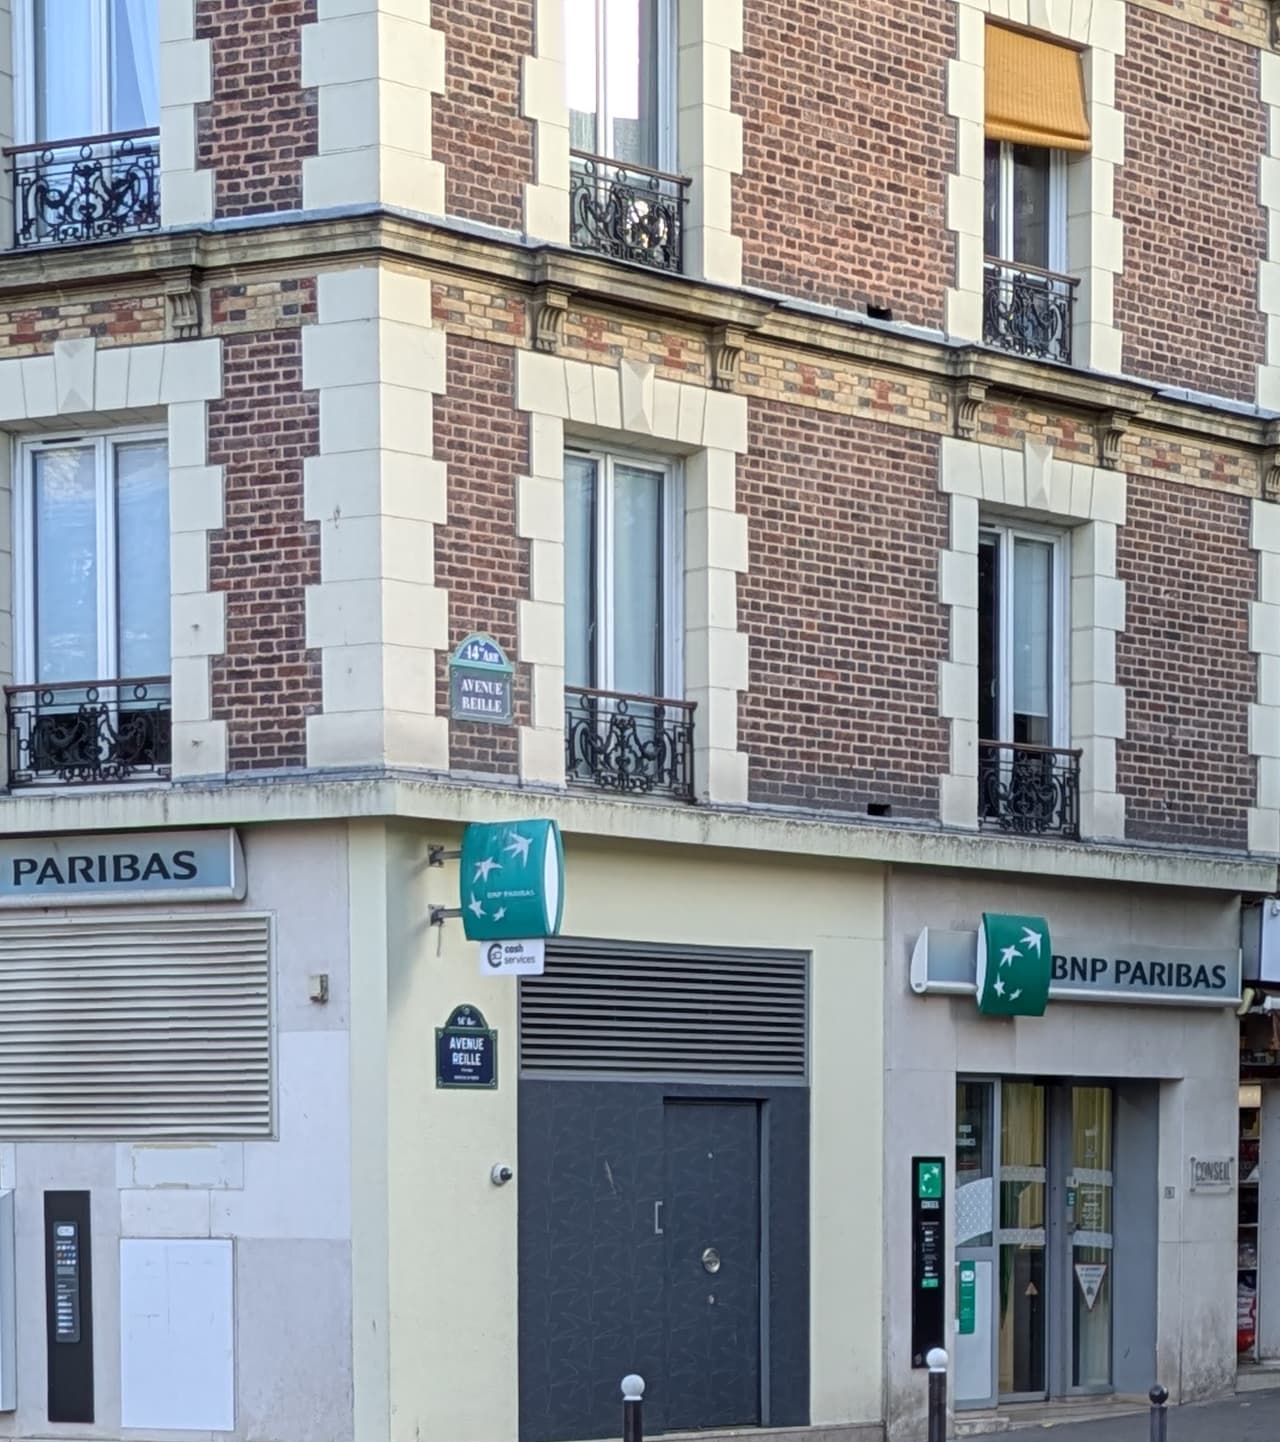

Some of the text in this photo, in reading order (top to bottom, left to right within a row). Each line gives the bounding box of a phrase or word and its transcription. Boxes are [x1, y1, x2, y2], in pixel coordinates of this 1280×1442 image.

[461, 679, 503, 695] AVENUE
[462, 696, 502, 713] REILLE
[13, 850, 198, 886] PARIBAS
[504, 943, 524, 954] cash
[504, 955, 535, 965] services
[1051, 955, 1226, 989] BNP PARIBAS
[449, 1036, 485, 1051] AVENUE
[452, 1052, 482, 1066] REILLE
[1195, 1161, 1231, 1182] CONSEIL
